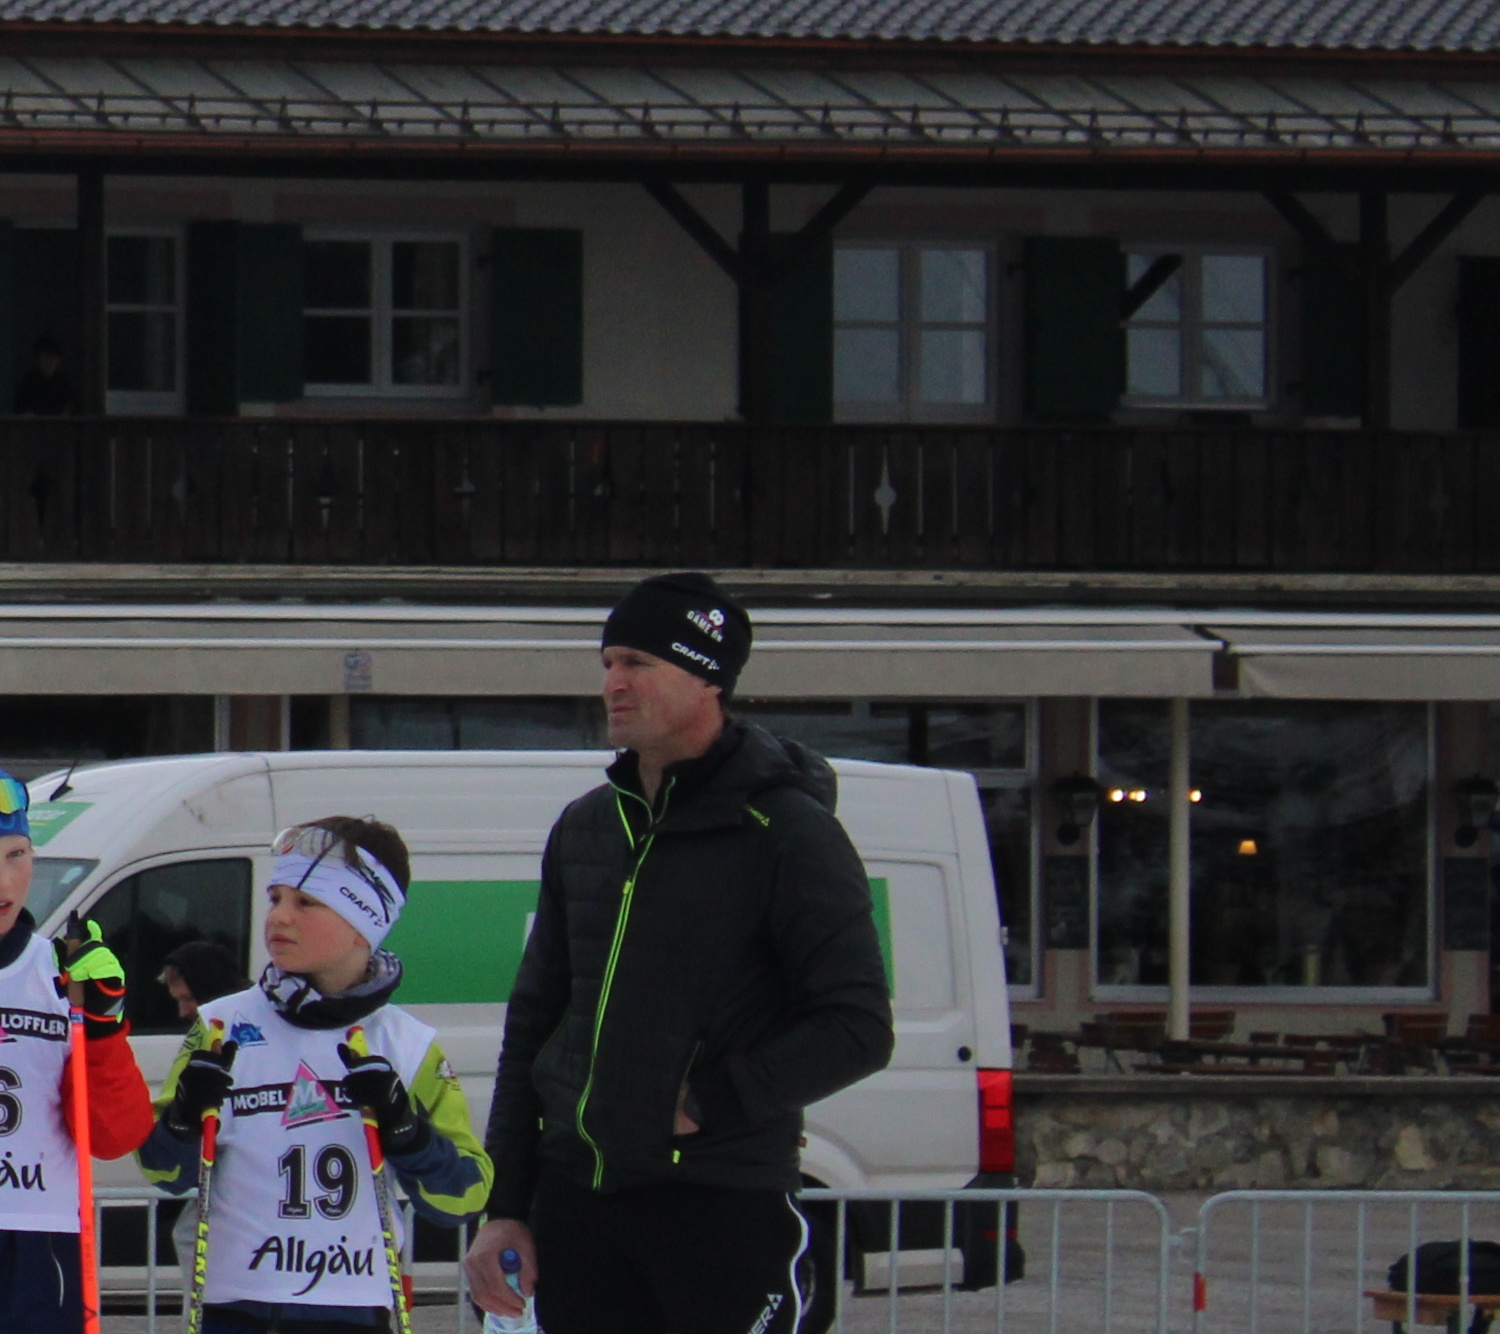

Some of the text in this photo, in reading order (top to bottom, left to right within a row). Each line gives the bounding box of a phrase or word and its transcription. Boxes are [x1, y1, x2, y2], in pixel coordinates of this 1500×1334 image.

[671, 642, 711, 668] CRAFT
[339, 886, 378, 919] CRAFT
[0, 1012, 67, 1037] LÖFFLER
[277, 1144, 358, 1220] 19
[193, 1221, 210, 1286] LEKI
[248, 1235, 374, 1297] Allgäu
